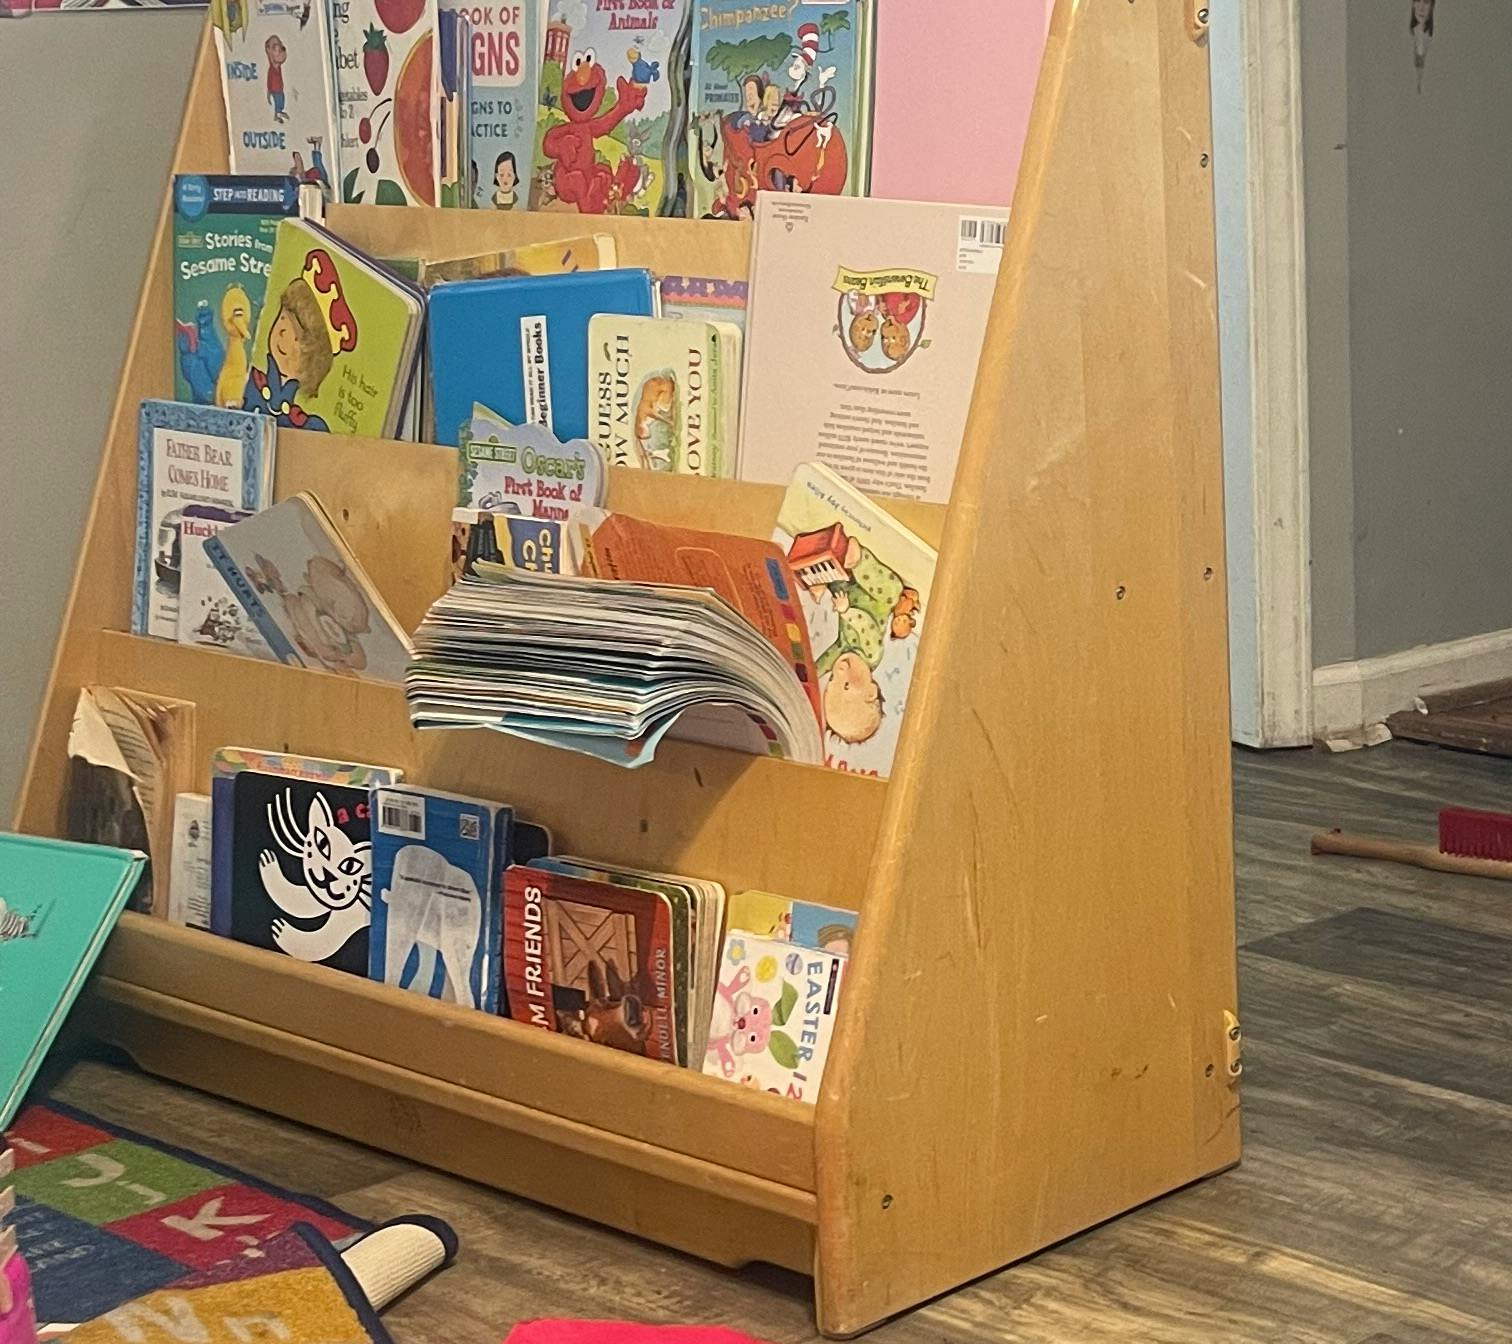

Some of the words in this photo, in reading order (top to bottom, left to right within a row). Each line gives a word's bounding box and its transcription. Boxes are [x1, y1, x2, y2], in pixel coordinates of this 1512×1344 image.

[499, 6, 520, 25] OF
[608, 12, 658, 30] Animals
[471, 31, 520, 76] GNS
[227, 61, 258, 81] INSIDE
[471, 101, 493, 115] GNS
[497, 101, 512, 115] TO
[243, 131, 286, 150] OUTSIDE
[471, 123, 508, 137] ACTICE
[213, 188, 233, 201] STEP
[247, 188, 284, 202] READING
[205, 228, 253, 250] Stories
[254, 239, 273, 253] from
[180, 256, 236, 280] Sesame
[240, 252, 272, 277] Stre
[532, 323, 544, 364] Books
[615, 335, 632, 425] MUCH
[687, 348, 703, 410] YOU
[204, 444, 233, 467] BEAR
[615, 433, 630, 467] OW
[687, 414, 702, 476] OVE
[520, 446, 586, 481] Oscar's
[200, 468, 229, 492] HOME
[504, 475, 533, 496] First
[536, 479, 567, 501] Book
[569, 483, 583, 502] of
[532, 499, 569, 522] Manne
[524, 886, 545, 997] FRIENDS
[656, 949, 666, 1001] MINOR
[797, 961, 823, 1062] EASTER
[659, 1002, 671, 1062] ENDELL
[161, 1196, 276, 1241] K
